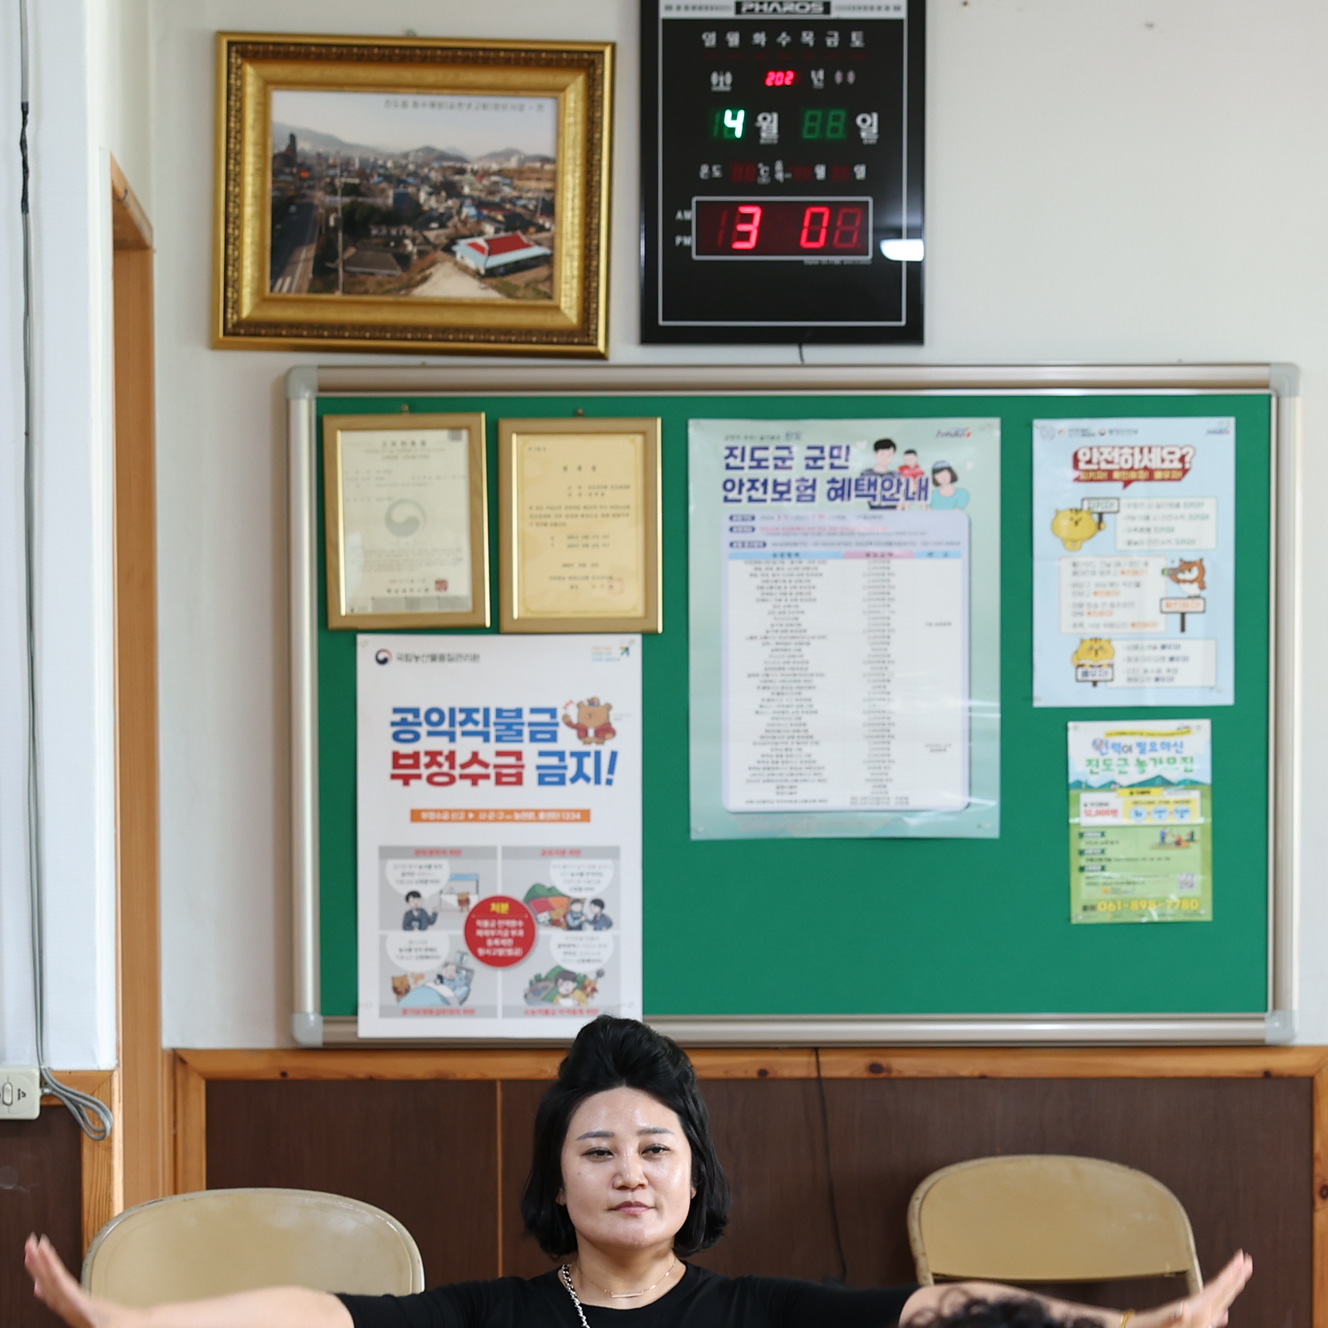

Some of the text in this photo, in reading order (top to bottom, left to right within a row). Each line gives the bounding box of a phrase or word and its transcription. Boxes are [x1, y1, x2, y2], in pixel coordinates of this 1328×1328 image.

[741, 1, 824, 14] PHAROS
[702, 31, 865, 47] 일 월 화 수 목 금 토
[724, 109, 744, 138] 4
[755, 112, 779, 137] 월
[856, 112, 878, 138] 일
[723, 444, 851, 471] 진도군 군민
[1076, 446, 1196, 471] 안전하세요?
[722, 476, 931, 504] 안전보험 혜택안내
[390, 706, 560, 745] 공익직불금
[390, 750, 619, 787] 부정수급 금지!
